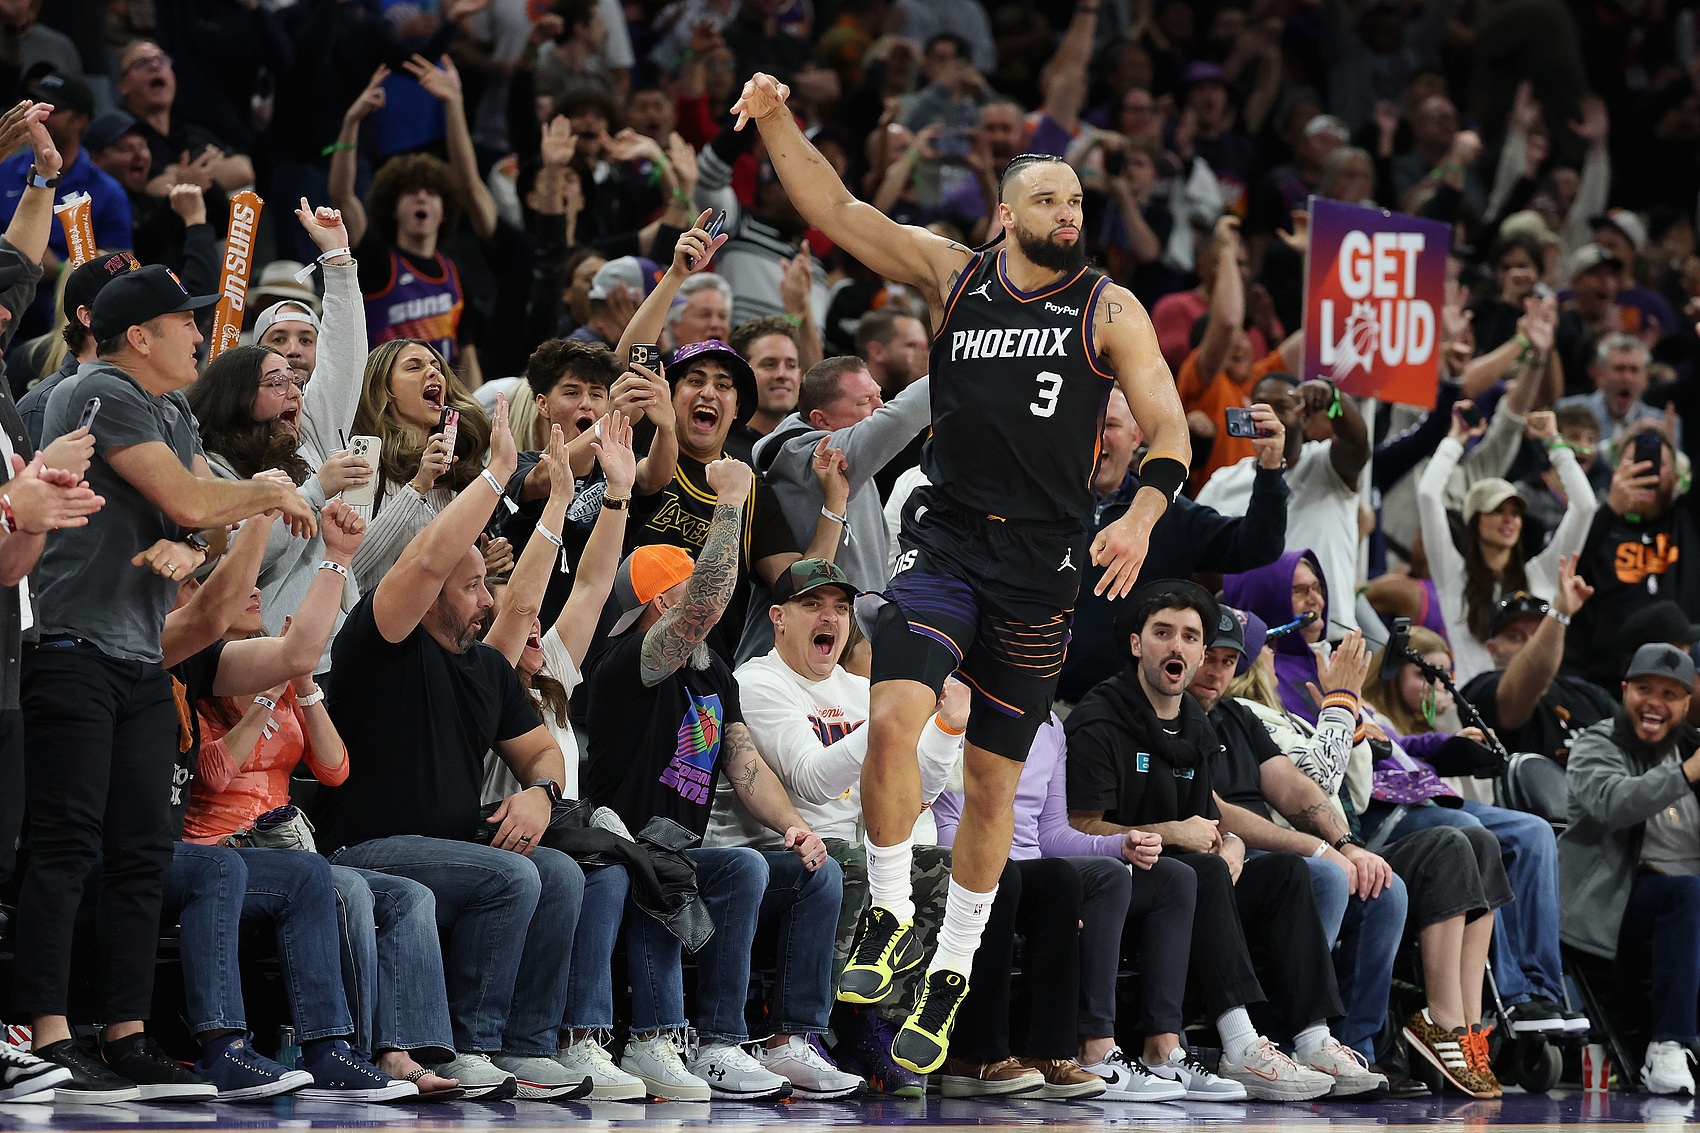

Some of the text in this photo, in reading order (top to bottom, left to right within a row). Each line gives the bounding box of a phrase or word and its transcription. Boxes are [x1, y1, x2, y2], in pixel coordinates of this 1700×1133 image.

[103, 254, 125, 276] THE
[223, 203, 255, 312] SUNS UP
[1338, 230, 1426, 298] GET
[387, 292, 453, 325] SUNS
[1043, 301, 1080, 317] PayPal
[1103, 301, 1123, 324] P
[211, 310, 220, 337] PHOENIX
[951, 327, 1073, 362] PHOENIX
[1029, 370, 1064, 418] 3
[579, 487, 602, 504] VANS
[573, 506, 587, 519] OFF
